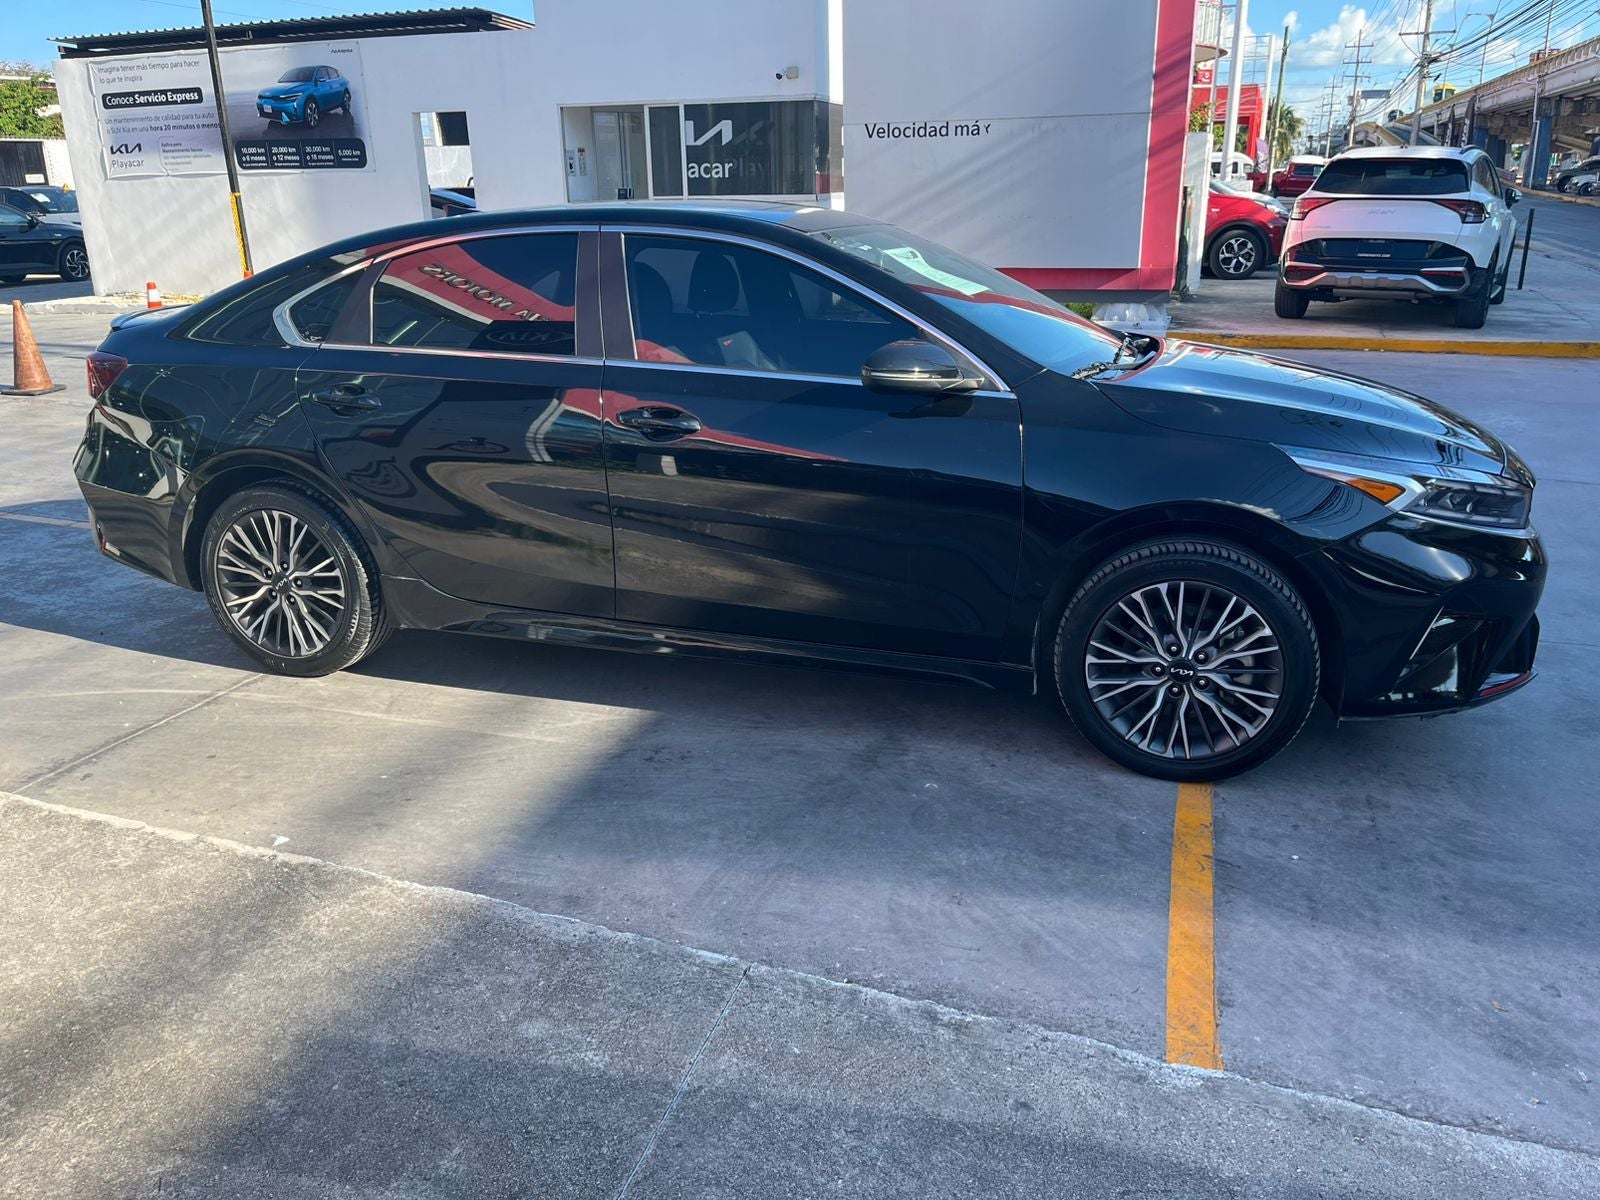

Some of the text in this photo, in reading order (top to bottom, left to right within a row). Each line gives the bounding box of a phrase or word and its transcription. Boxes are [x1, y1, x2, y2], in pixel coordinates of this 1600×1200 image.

[98, 66, 120, 75] Imagina
[148, 62, 169, 71] tiempo
[170, 62, 183, 70] para
[106, 77, 116, 85] que
[124, 75, 143, 83] inspira
[106, 92, 199, 106] Conoce Servicio Express
[864, 121, 949, 138] Velocidad
[112, 159, 144, 169] Playacar
